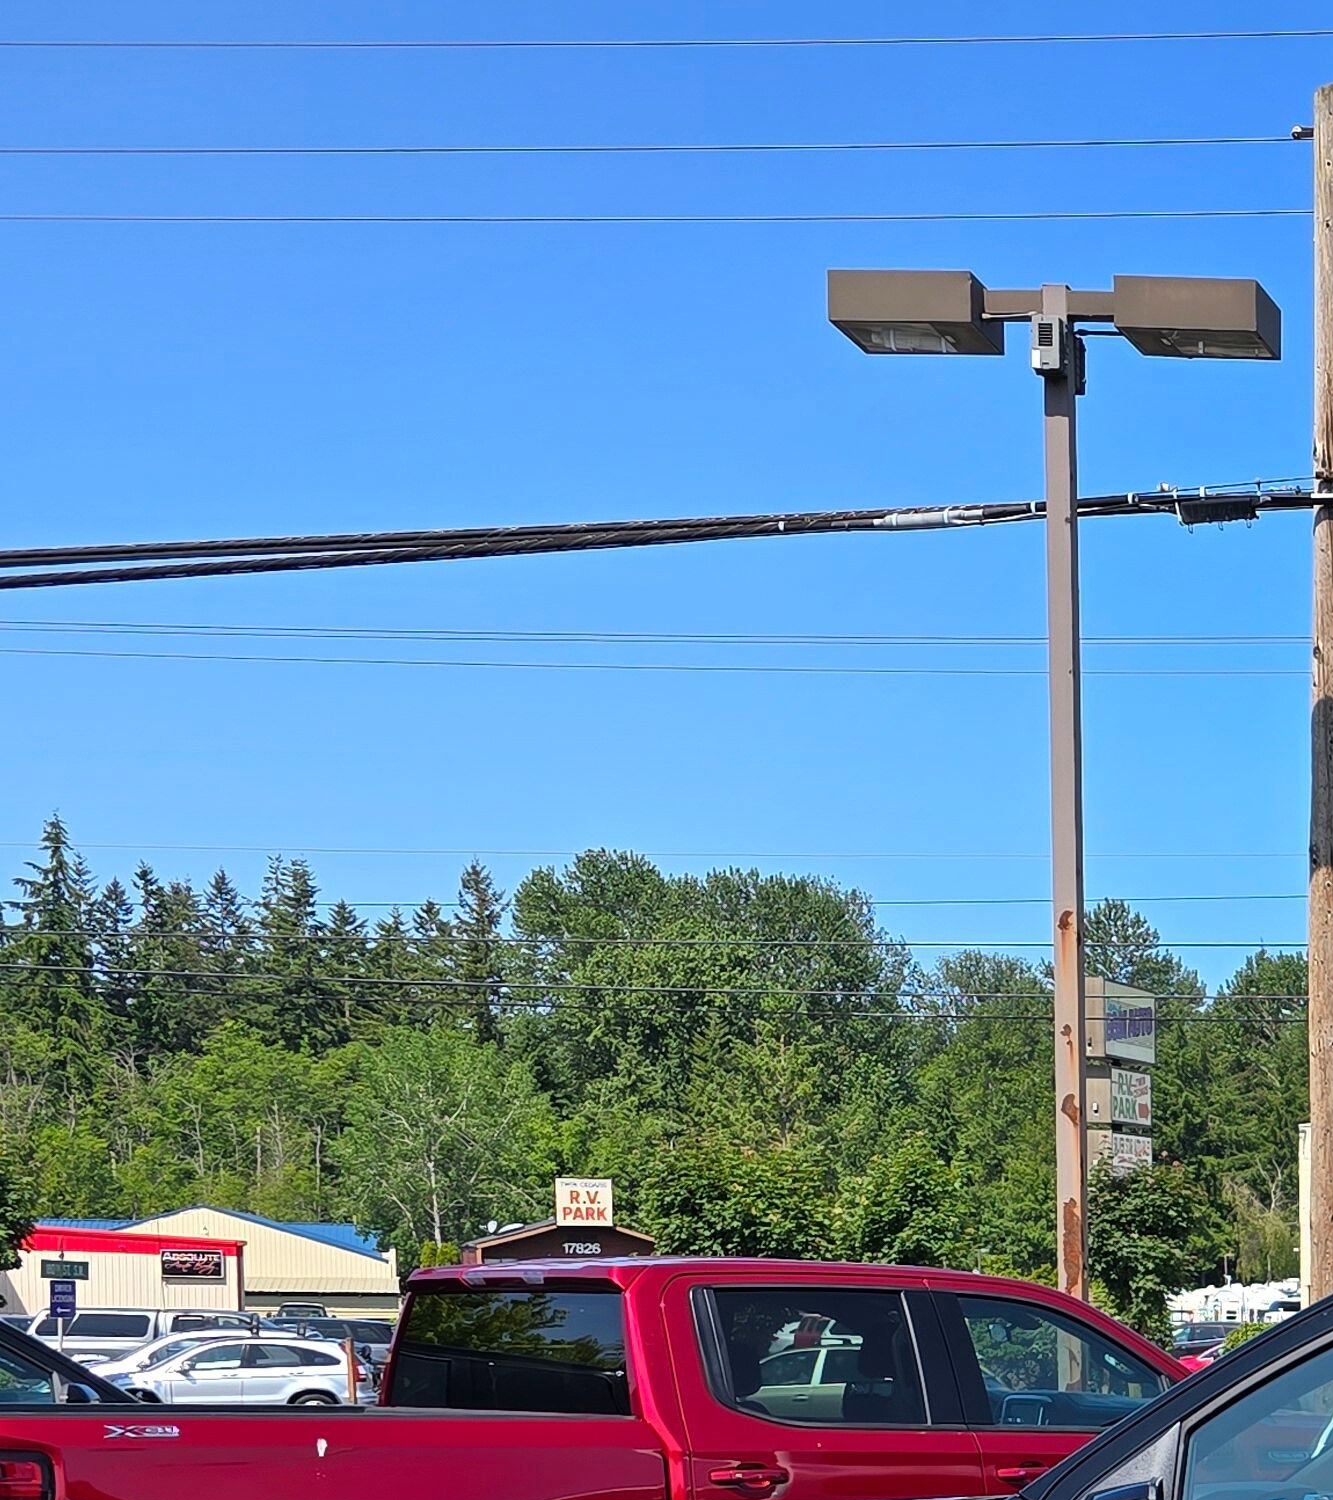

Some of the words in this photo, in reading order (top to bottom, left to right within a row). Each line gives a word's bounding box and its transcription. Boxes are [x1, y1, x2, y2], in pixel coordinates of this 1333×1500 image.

[1112, 1096, 1137, 1120] PARK
[569, 1190, 601, 1205] R.V.
[562, 1206, 608, 1221] PARK
[562, 1242, 602, 1254] 17826
